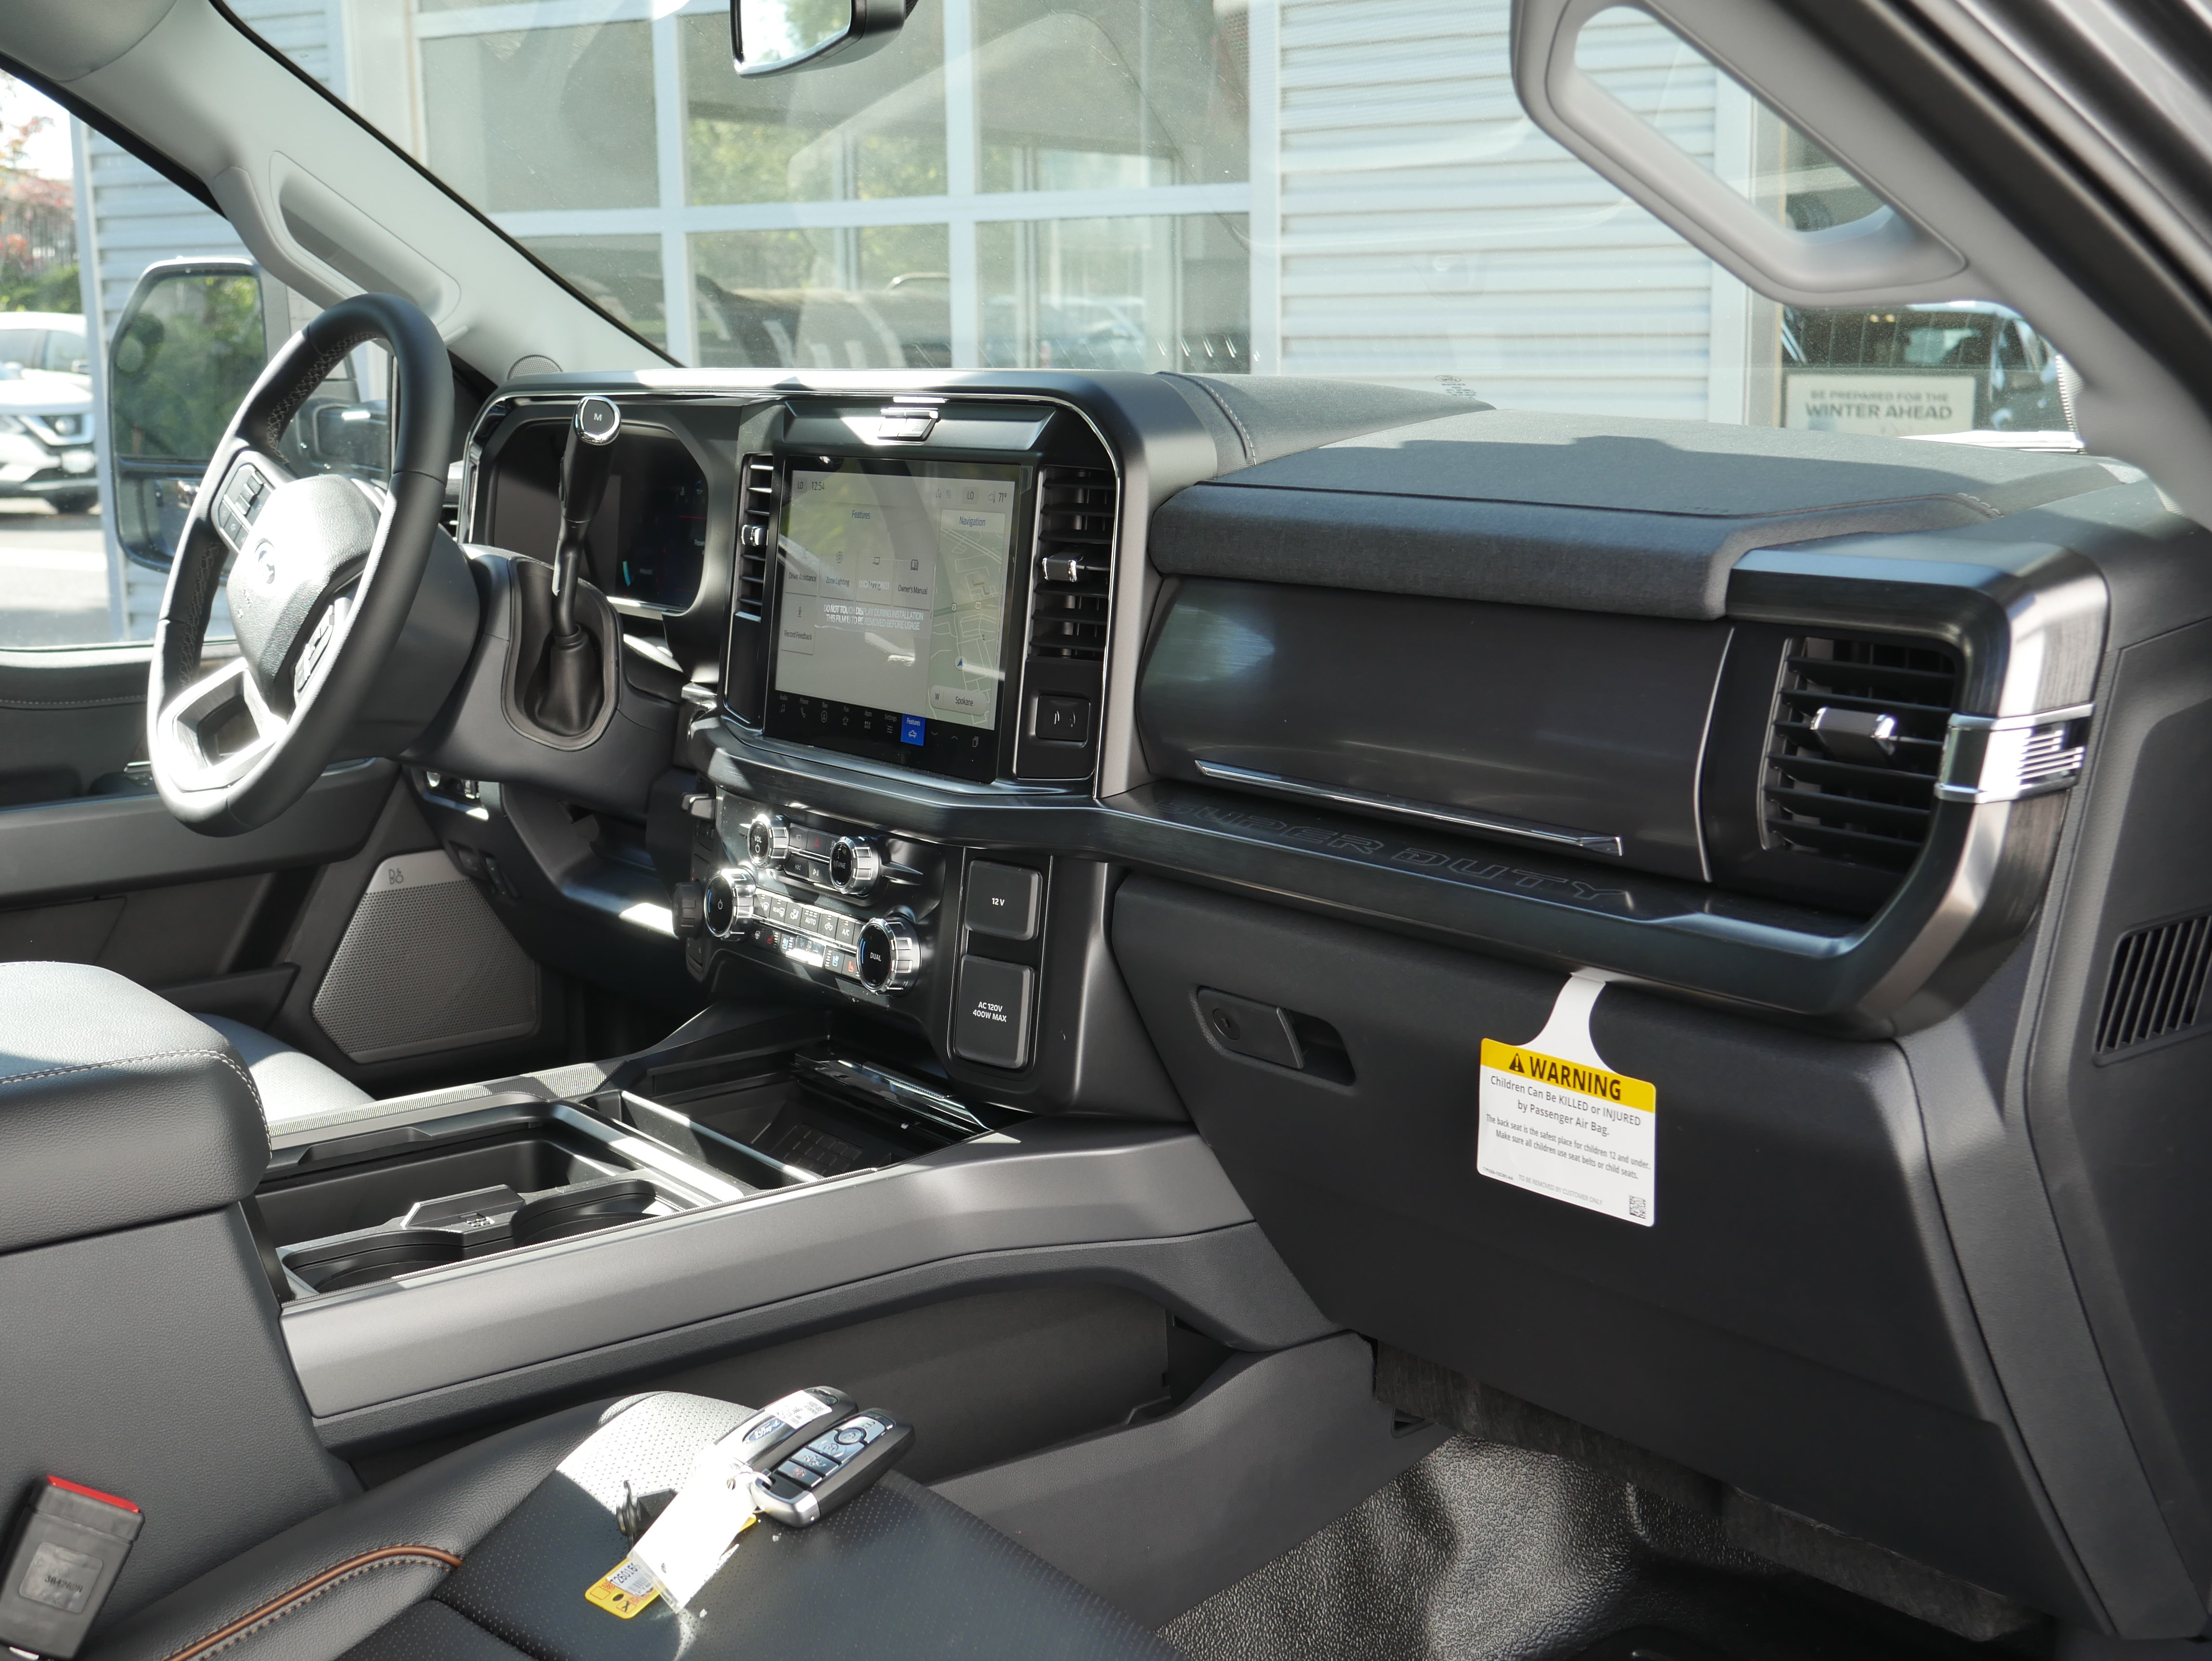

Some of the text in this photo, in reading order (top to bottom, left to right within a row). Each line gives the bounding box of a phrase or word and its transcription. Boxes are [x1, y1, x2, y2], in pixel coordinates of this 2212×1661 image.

[1830, 391, 1894, 401] PREPARED
[1896, 391, 1922, 402] FOR
[1926, 392, 1949, 402] THE
[1805, 403, 1953, 420] WINTER AHEAD
[812, 482, 825, 491] 12:54
[967, 491, 974, 500] LO
[999, 492, 1007, 502] 71°
[852, 510, 870, 519] Features
[960, 516, 986, 527] Navigation
[799, 574, 816, 582] Assistance
[835, 578, 850, 587] Lighting
[898, 585, 927, 595] Owner's Manual
[830, 605, 840, 613] NOT
[840, 606, 855, 615] TOUCH
[856, 607, 874, 616] DISPLAY
[874, 608, 892, 618] DURING
[892, 609, 923, 620] INSTALLATION
[836, 615, 846, 623] FILM
[858, 617, 864, 625] BE
[784, 630, 812, 640] Record Feedback
[956, 697, 974, 707] Spokane
[884, 713, 897, 722] Settings
[907, 718, 921, 726] Features
[1157, 798, 1627, 900] SUPER DUTY
[805, 917, 816, 925] AUTO
[870, 952, 881, 962] DUAL
[978, 1002, 1002, 1012] AC 120V
[973, 1009, 1007, 1022] 400W MAX
[1529, 1056, 1621, 1100] WARNING
[1491, 1075, 1641, 1126] Children Can Be KILLED or INJURED
[1518, 1100, 1610, 1136] by Passenger Air Bag.
[1487, 1114, 1651, 1170] The back seat is the safest place for children 12 and under.
[1496, 1130, 1511, 1141] Make
[1512, 1135, 1524, 1145] sure
[1534, 1142, 1556, 1154] children
[1557, 1149, 1567, 1158] use
[1568, 1152, 1580, 1162] seat
[1582, 1155, 1596, 1167] belts
[1606, 1163, 1620, 1174] child
[1621, 1168, 1639, 1180] seats.
[1532, 1179, 1554, 1191] REMOVED
[1563, 1188, 1589, 1201] CUSTOMER
[1590, 1197, 1603, 1205] ONLY
[754, 1420, 780, 1439] Ford
